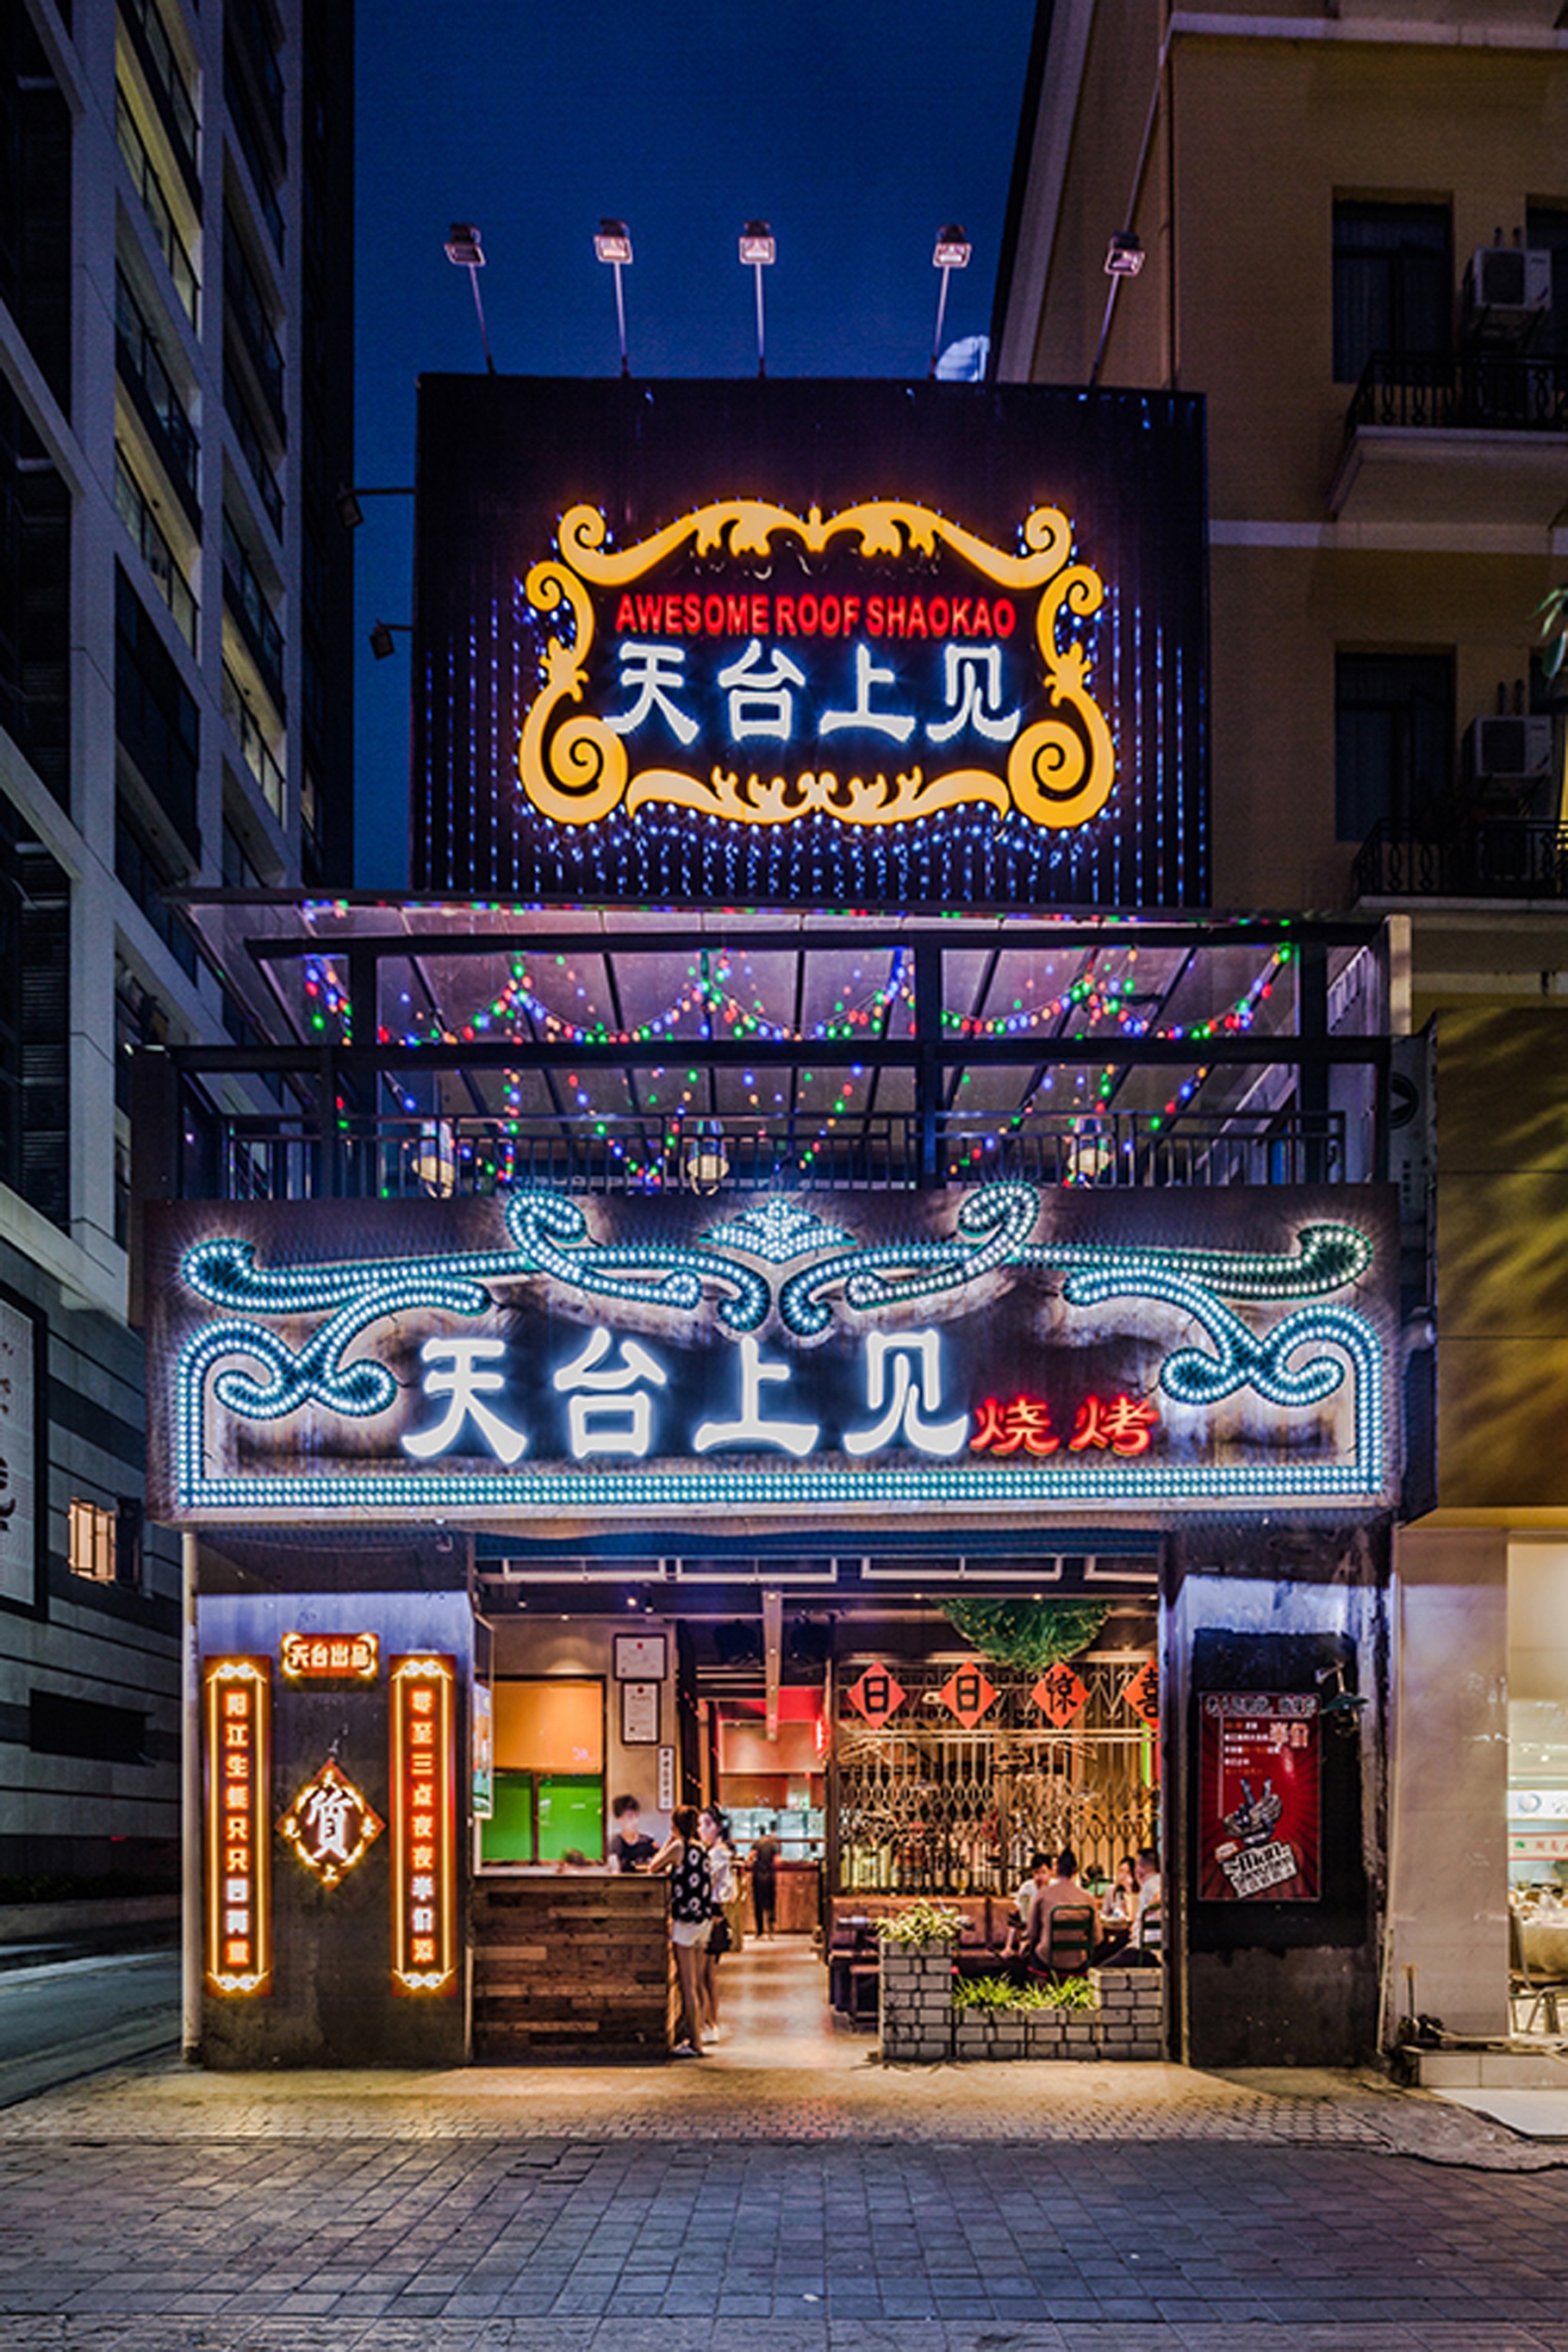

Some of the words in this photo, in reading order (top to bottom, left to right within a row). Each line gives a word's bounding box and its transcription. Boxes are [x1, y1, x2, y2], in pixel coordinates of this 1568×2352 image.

[616, 594, 768, 635] AWESOME
[776, 594, 860, 636] ROOF
[867, 595, 1017, 638] SHAOKAO
[603, 641, 1021, 744] 天台上见
[401, 1328, 968, 1465] 天台上见
[969, 1396, 1157, 1456] 烧烤
[289, 1643, 370, 1669] 天台出品
